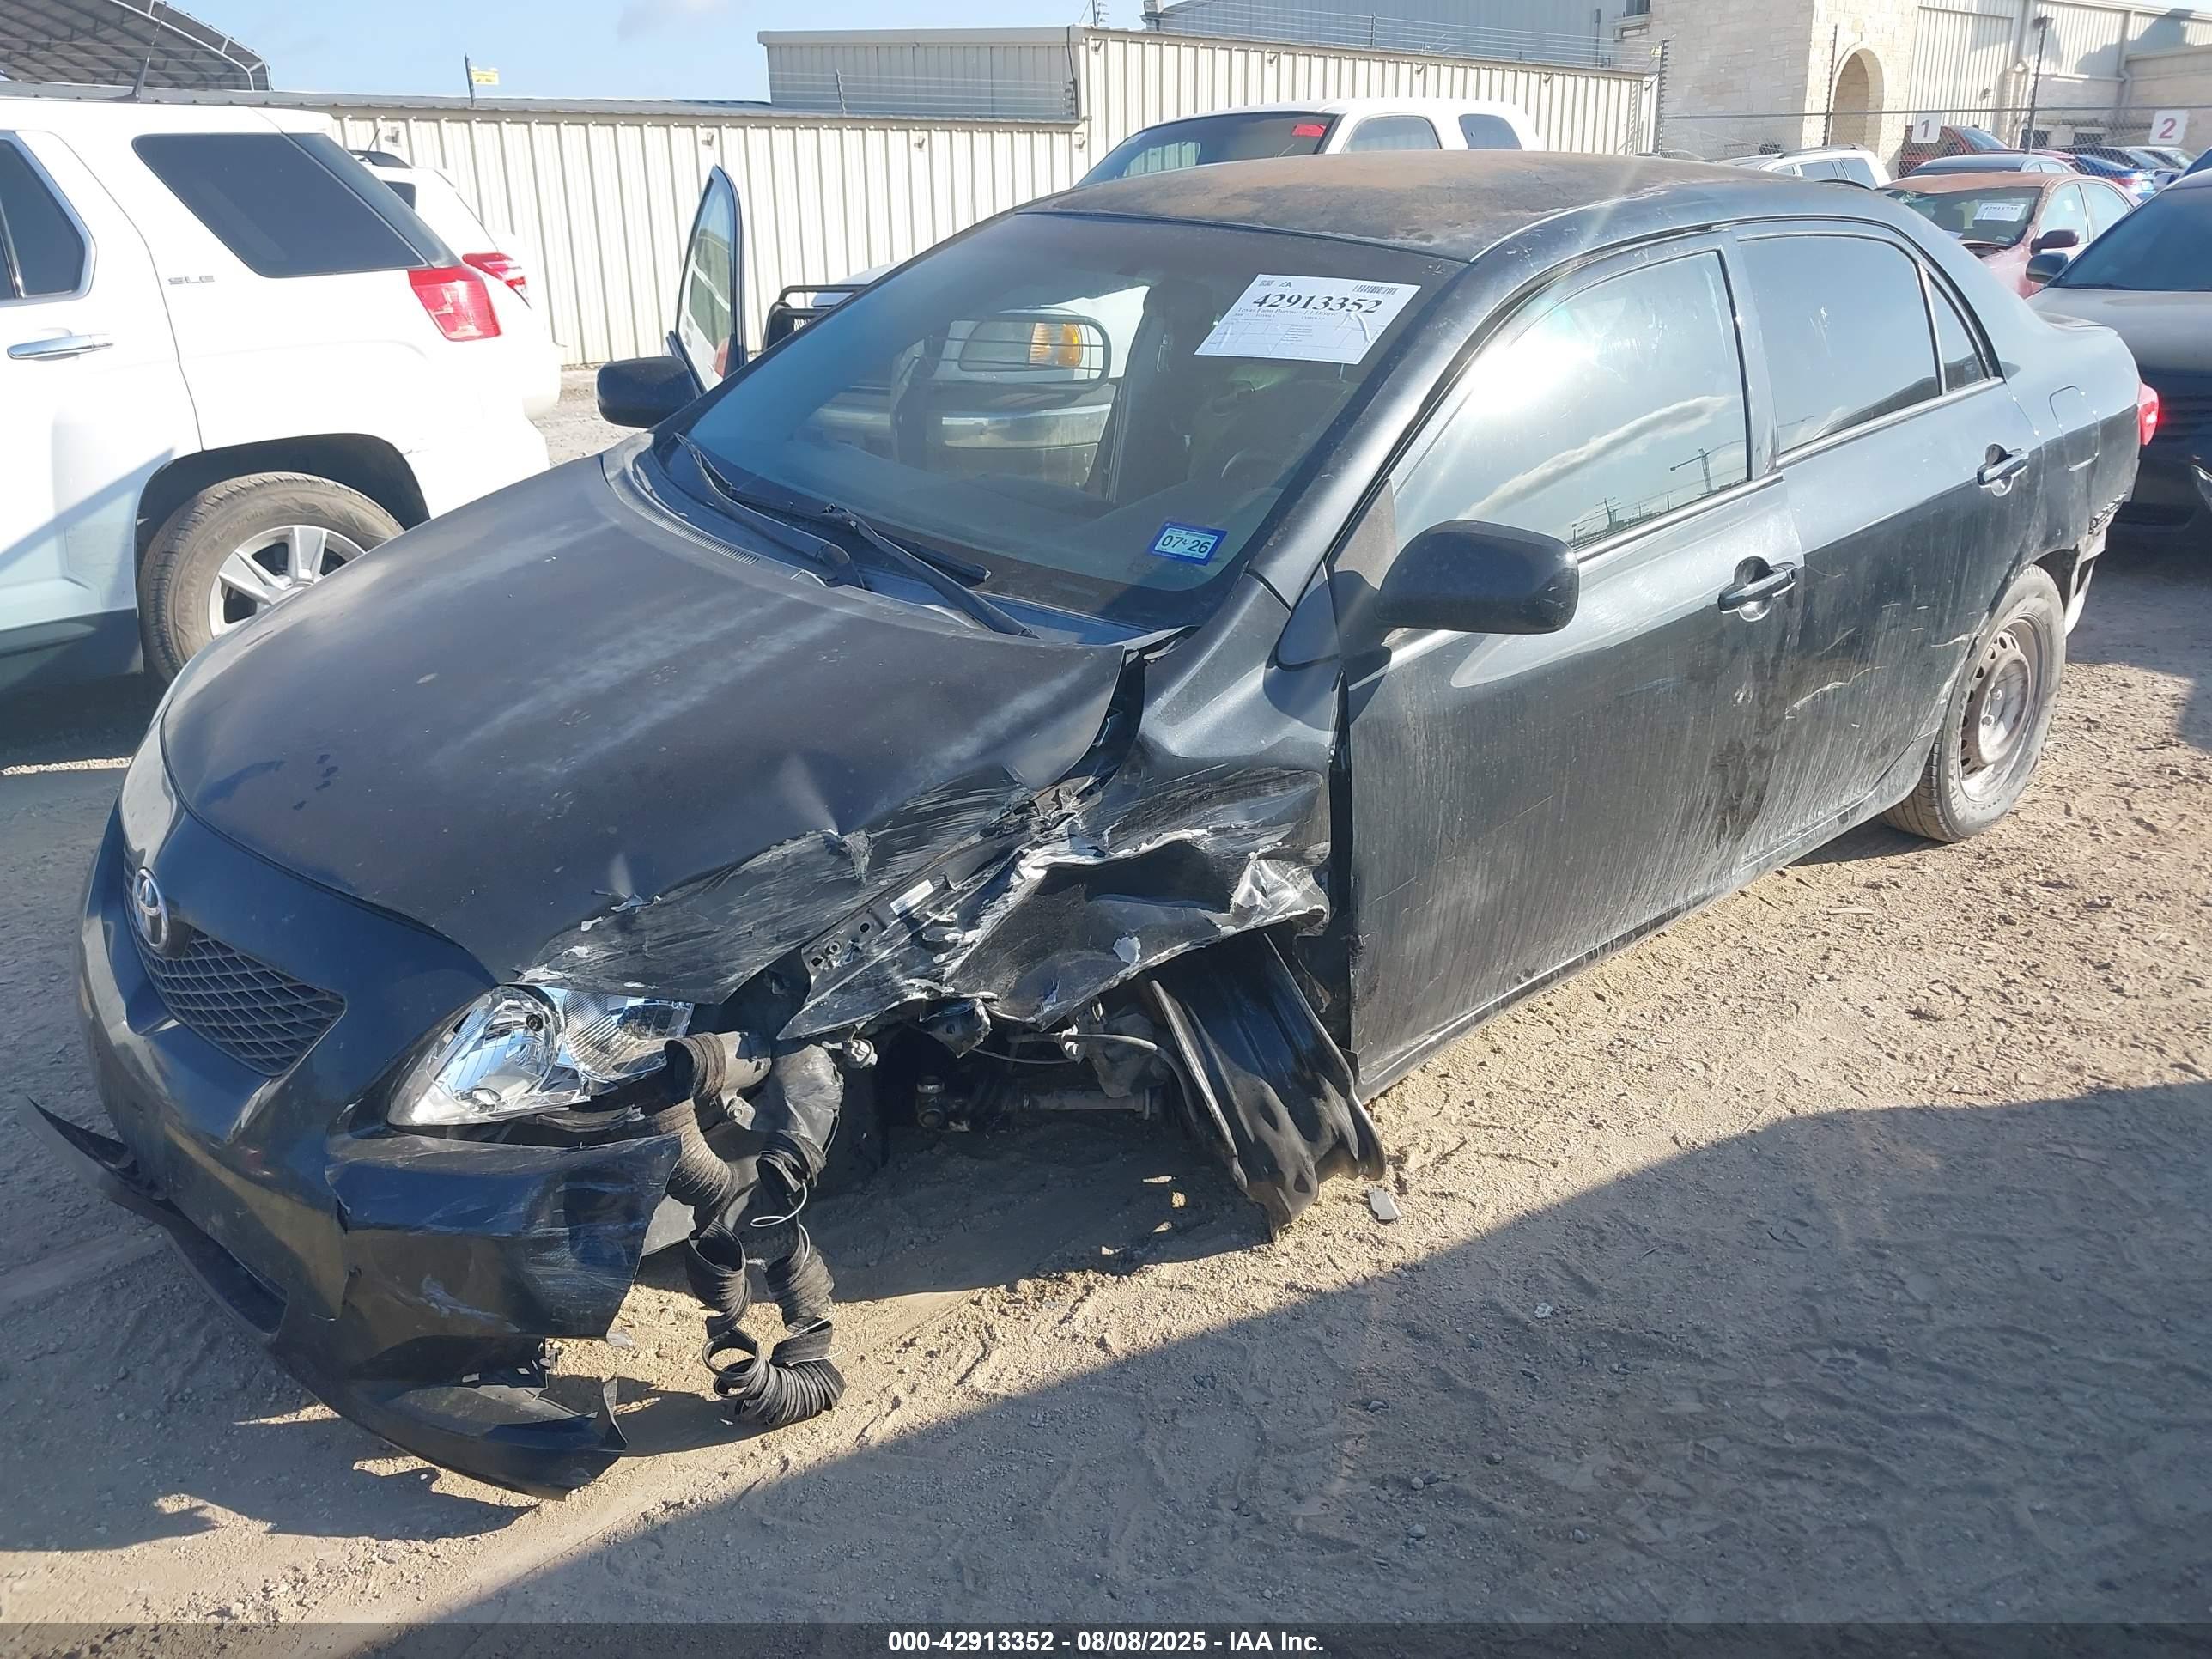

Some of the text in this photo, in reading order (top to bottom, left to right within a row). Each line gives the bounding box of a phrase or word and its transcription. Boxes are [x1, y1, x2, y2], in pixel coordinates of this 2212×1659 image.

[1921, 119, 1929, 138] 1
[2158, 117, 2177, 139] 2
[1252, 292, 1382, 313] 42913352
[1162, 535, 1183, 548] 07
[1187, 539, 1211, 553] 26
